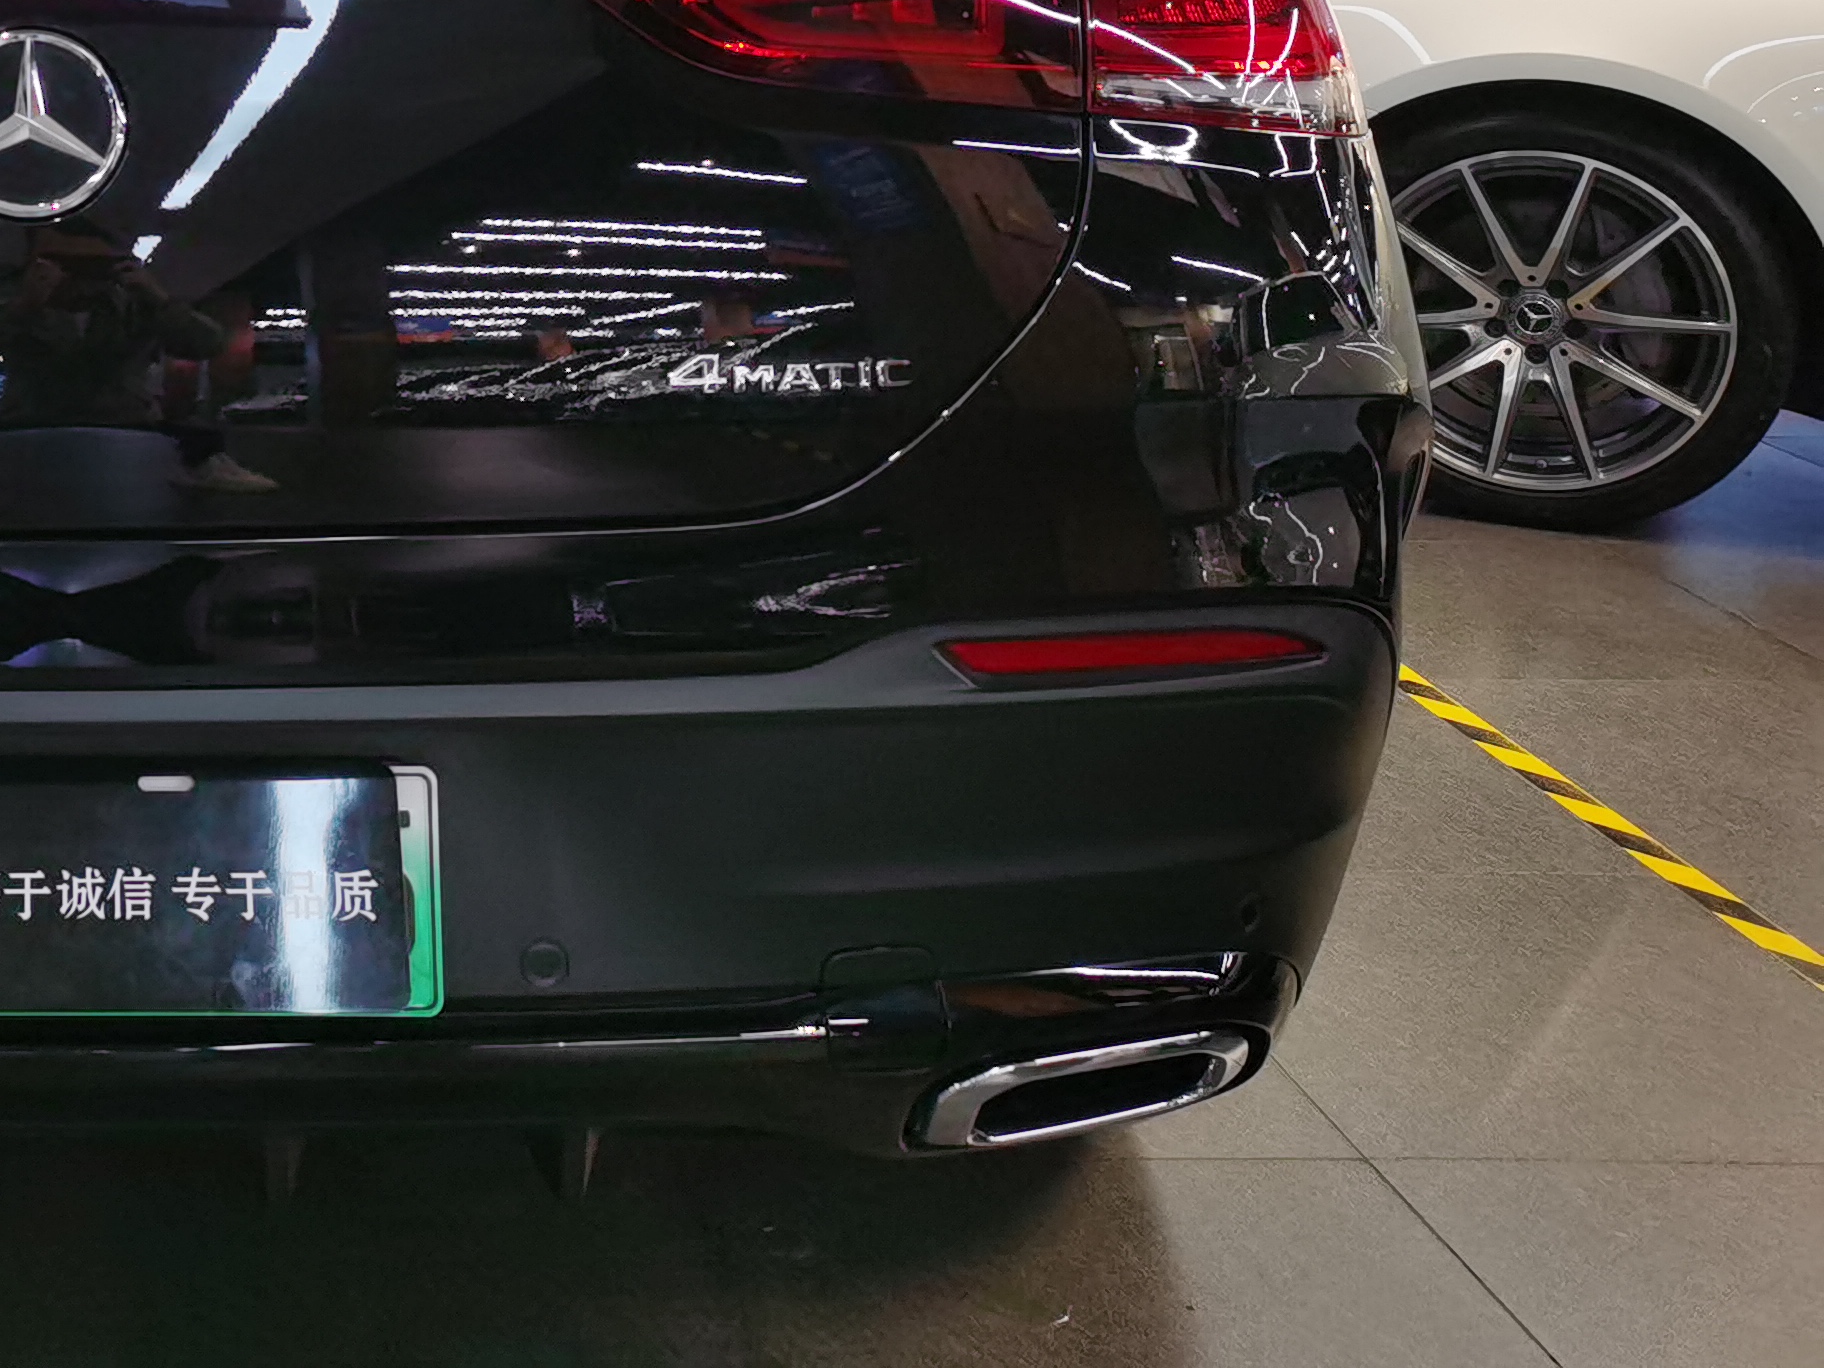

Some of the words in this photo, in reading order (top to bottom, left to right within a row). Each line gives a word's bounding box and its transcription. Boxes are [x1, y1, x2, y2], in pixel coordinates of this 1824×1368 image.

[666, 353, 914, 394] 4MATIC
[171, 867, 379, 922] 专于品质
